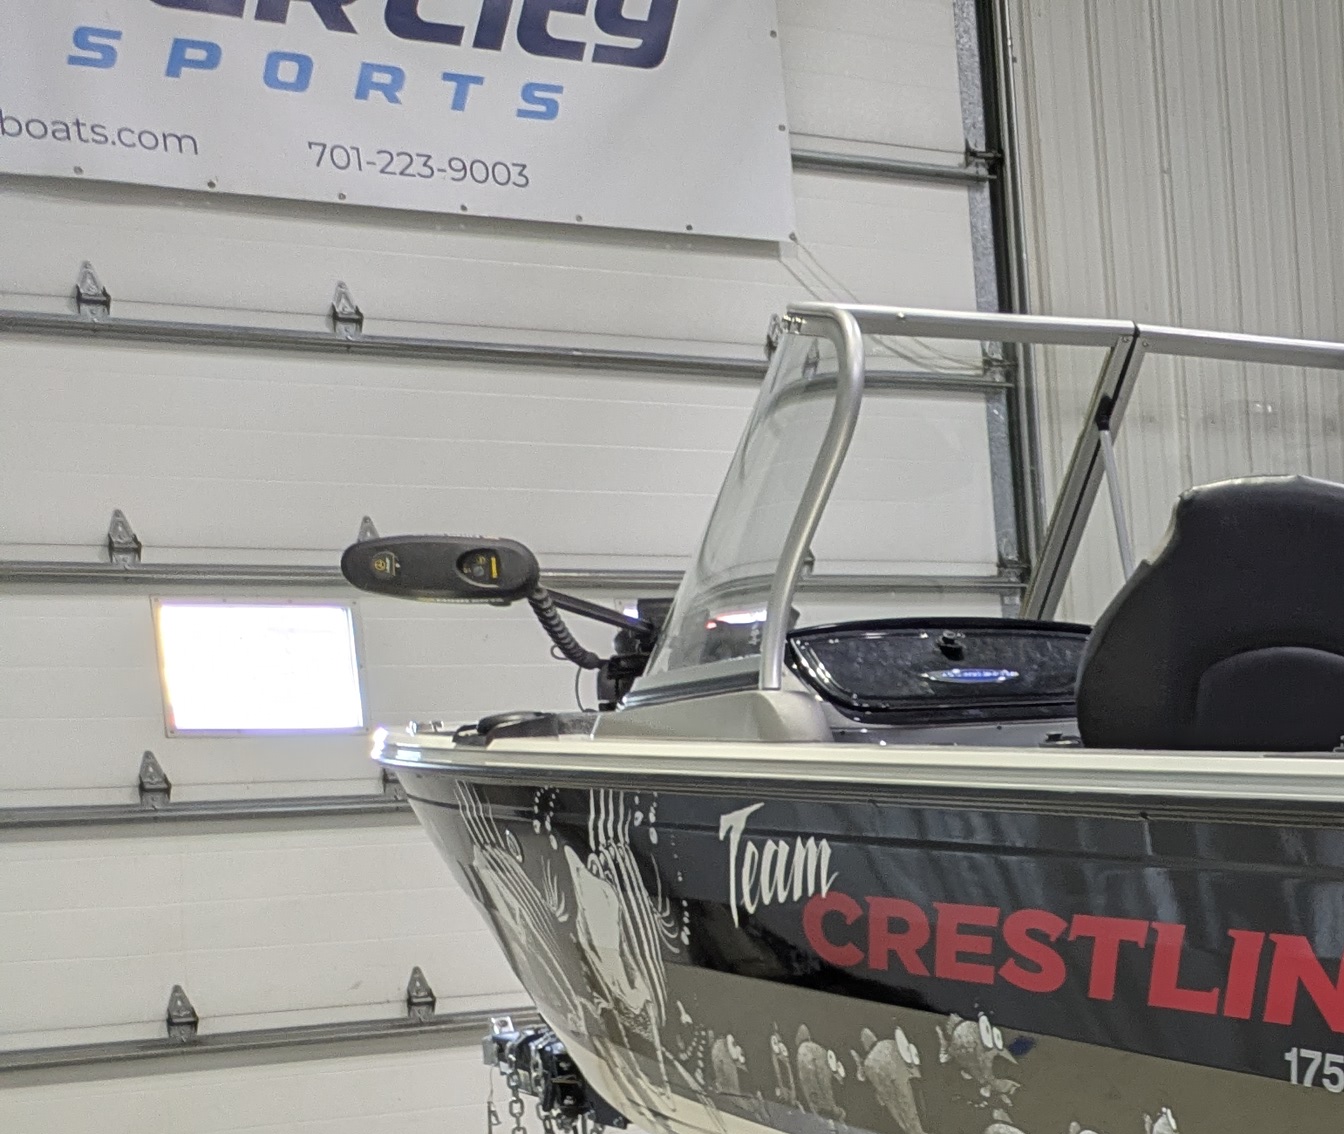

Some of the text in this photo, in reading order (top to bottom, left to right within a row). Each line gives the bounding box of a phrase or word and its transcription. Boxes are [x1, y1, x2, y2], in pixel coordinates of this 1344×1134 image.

[67, 26, 565, 121] SPORTS
[307, 141, 530, 188] 701-223-9003
[719, 802, 839, 928] Team
